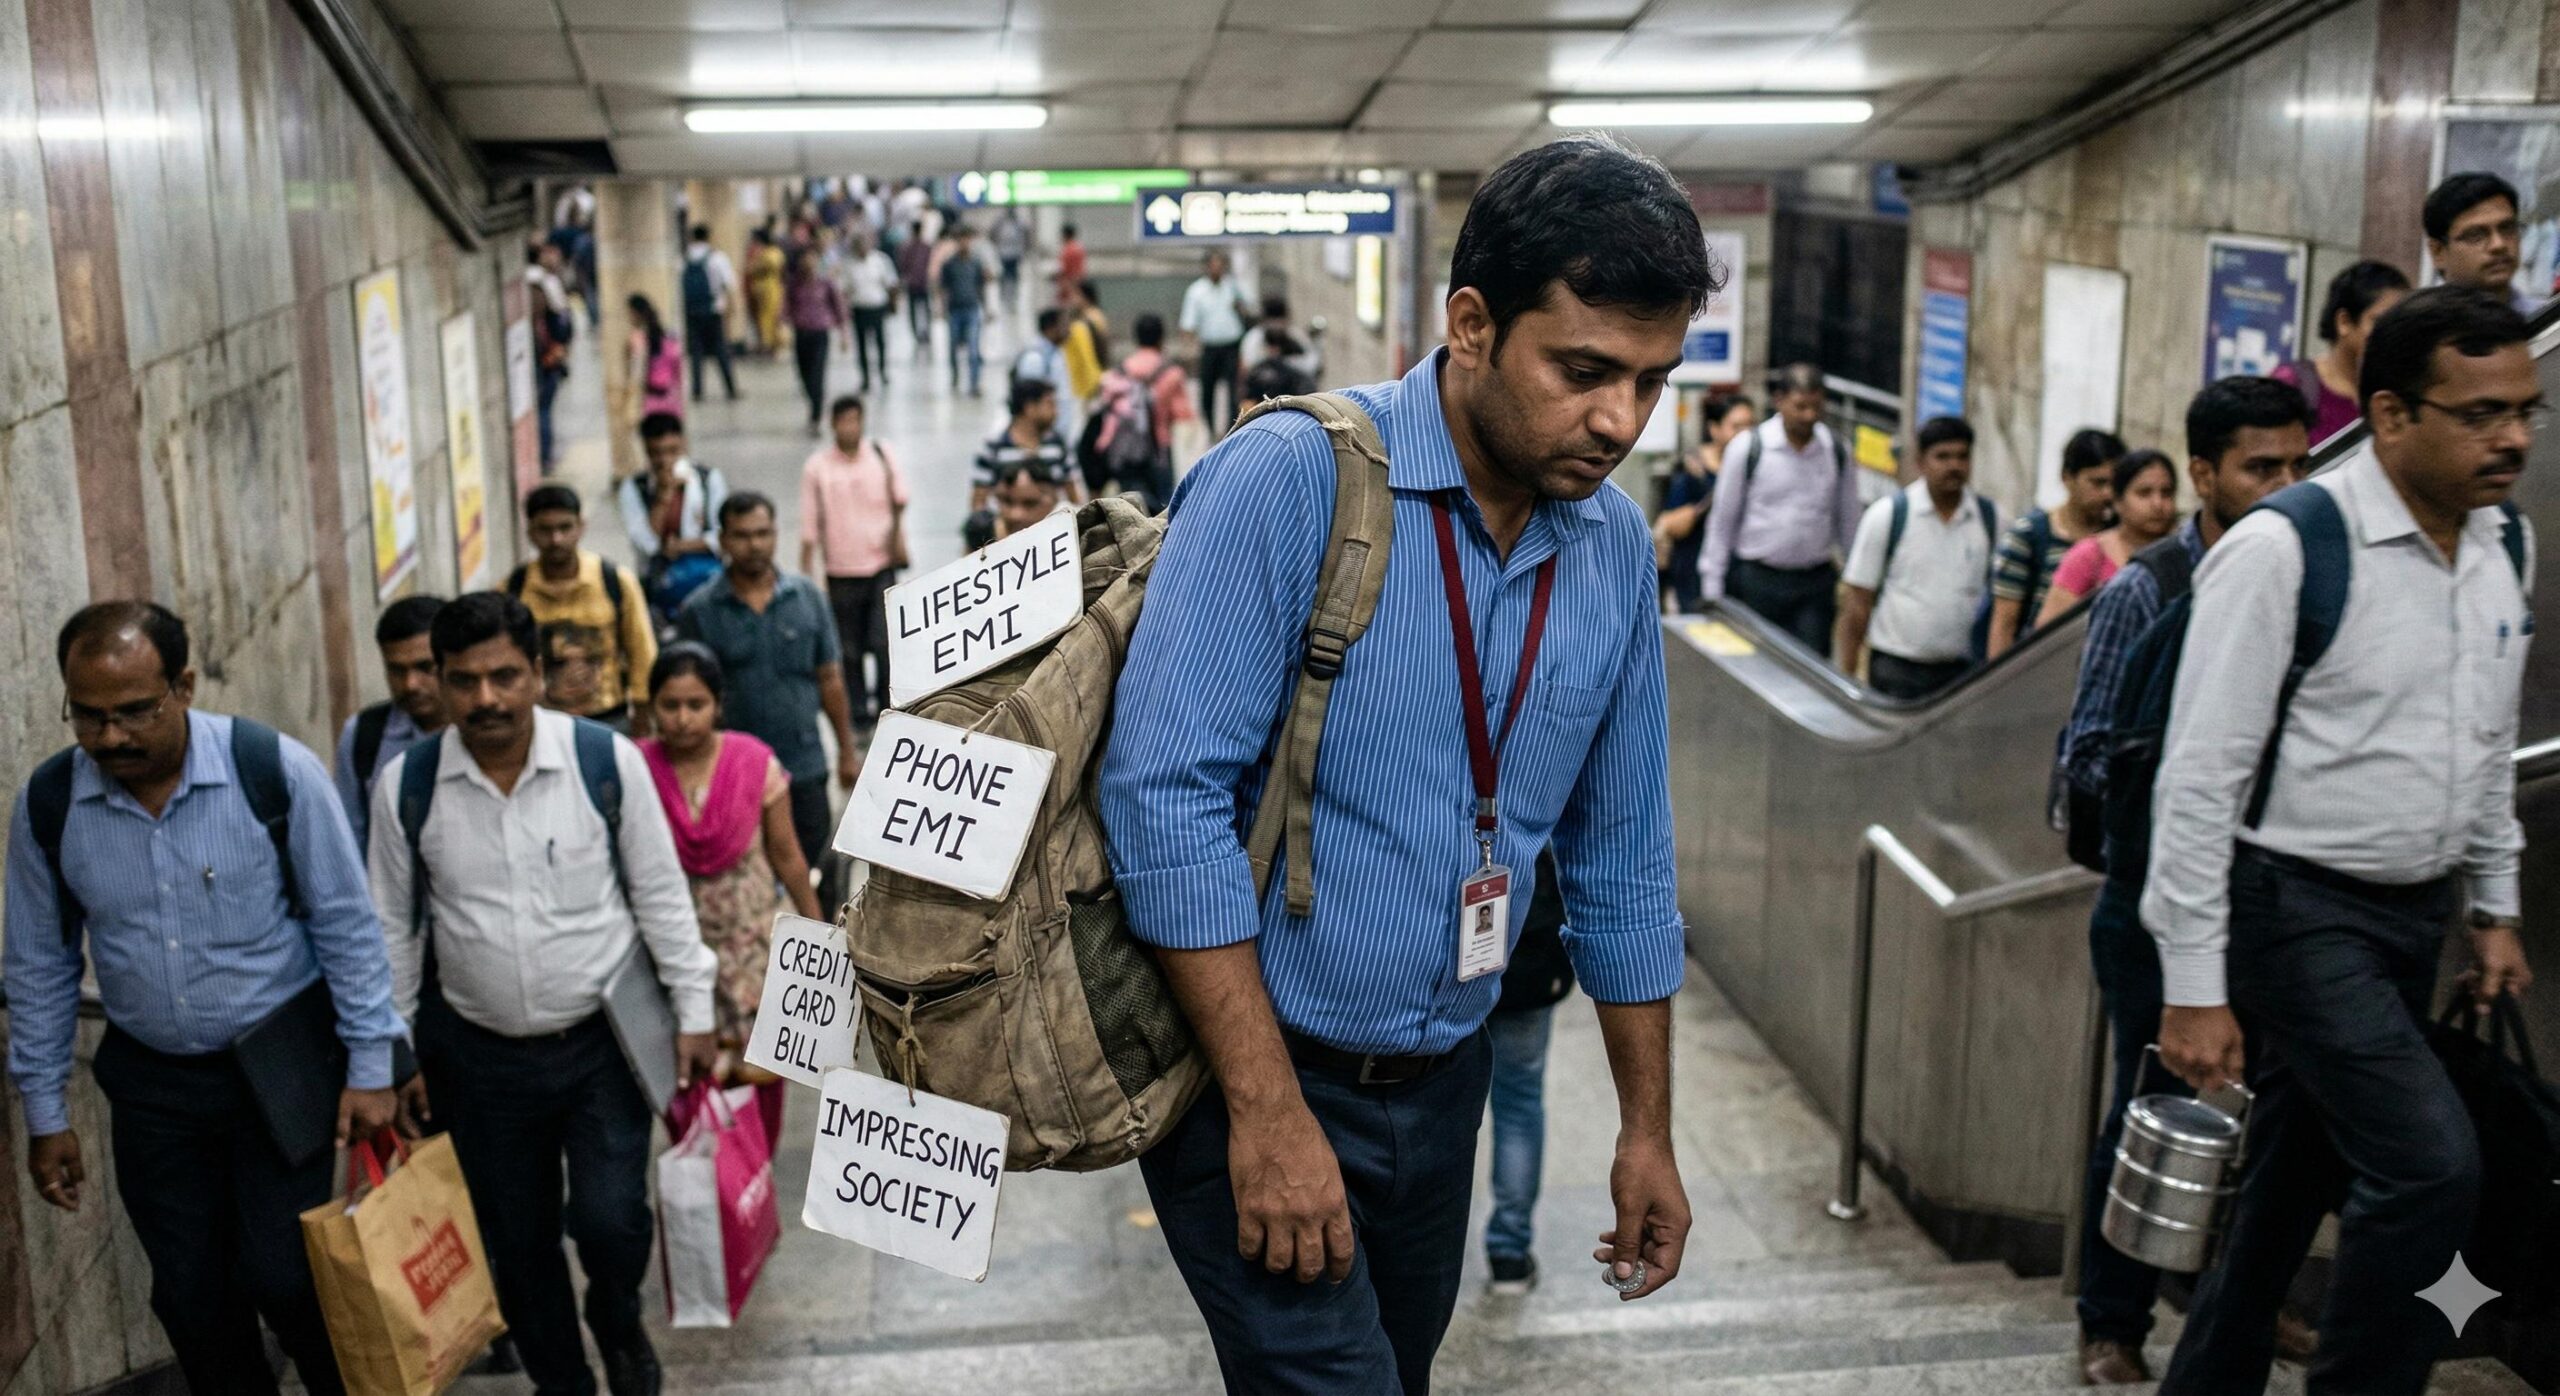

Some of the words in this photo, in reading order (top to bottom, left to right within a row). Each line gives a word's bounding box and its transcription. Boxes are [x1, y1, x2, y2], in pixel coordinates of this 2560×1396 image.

[899, 532, 1070, 638] LIFESTYLE
[933, 605, 1022, 673] EMI
[886, 738, 1013, 806] PHONE
[882, 799, 977, 861] EMI
[779, 937, 850, 987] CREDIT
[782, 984, 836, 1026] CARD
[774, 1026, 818, 1073] BILL
[820, 1098, 1000, 1187] IMPRESSING
[836, 1162, 976, 1240] SOCIETY
